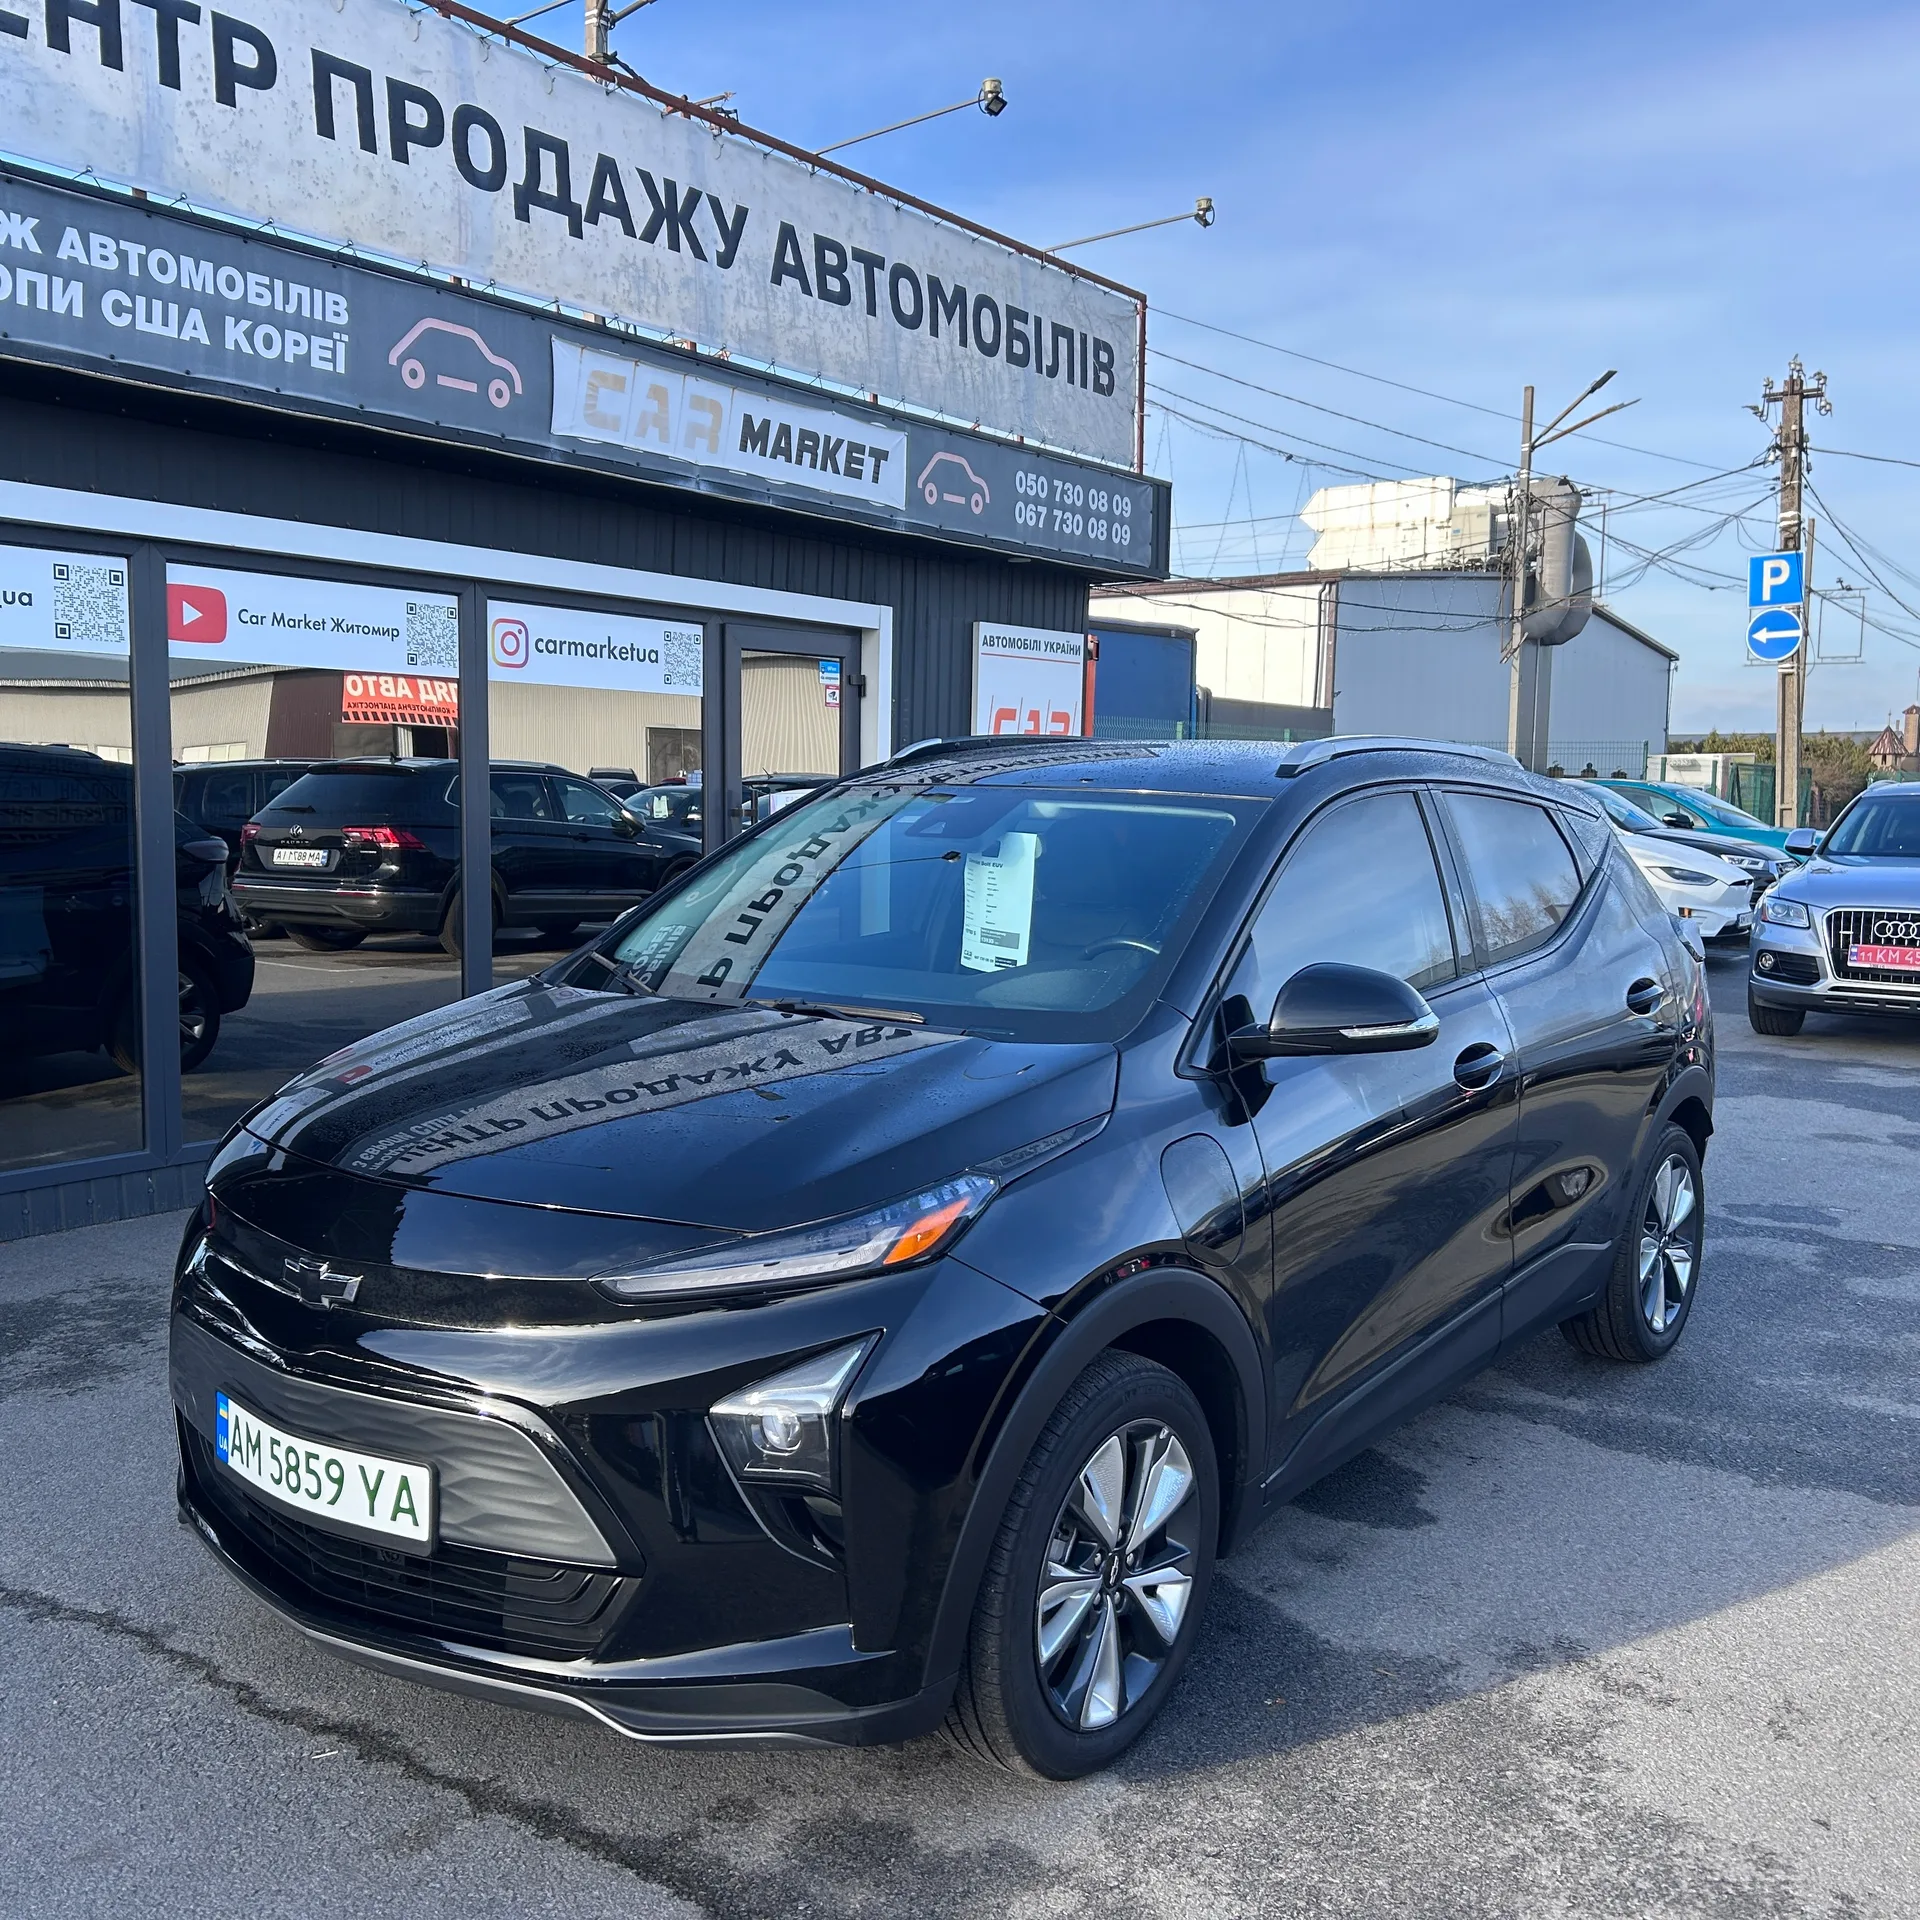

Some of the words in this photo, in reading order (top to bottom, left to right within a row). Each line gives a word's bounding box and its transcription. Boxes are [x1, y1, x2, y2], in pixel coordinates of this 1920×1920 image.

[0, 0, 277, 109] НТР
[310, 48, 748, 269] ПРОДАЖУ
[770, 220, 1116, 398] АВТОМОБІЛІВ
[56, 227, 349, 325] АВТОМОБІЛІВ
[101, 289, 211, 346] США
[224, 315, 349, 374] КОРЕЇ
[583, 370, 723, 454] CAR
[738, 412, 890, 484] MARKET
[1015, 470, 1048, 499] 050
[1053, 479, 1084, 507] 730
[1088, 488, 1108, 513] 08
[1112, 494, 1132, 518] 09
[1014, 500, 1047, 529] 067
[1052, 508, 1083, 536] 730
[1087, 517, 1107, 541] 08
[1111, 522, 1131, 546] 09
[1762, 558, 1790, 602] P
[237, 608, 266, 627] Car
[271, 612, 327, 632] Market
[330, 616, 400, 643] Житомир
[533, 632, 659, 664] carmarketua
[982, 634, 1041, 652] АВТОМОБІЛІ
[1044, 640, 1081, 657] УКРАЇНИ
[1860, 951, 1873, 962] 11
[1876, 948, 1900, 964] KM
[218, 1433, 229, 1452] UA
[230, 1414, 262, 1477] AM
[269, 1436, 345, 1506] 5859
[358, 1464, 420, 1527] YA
